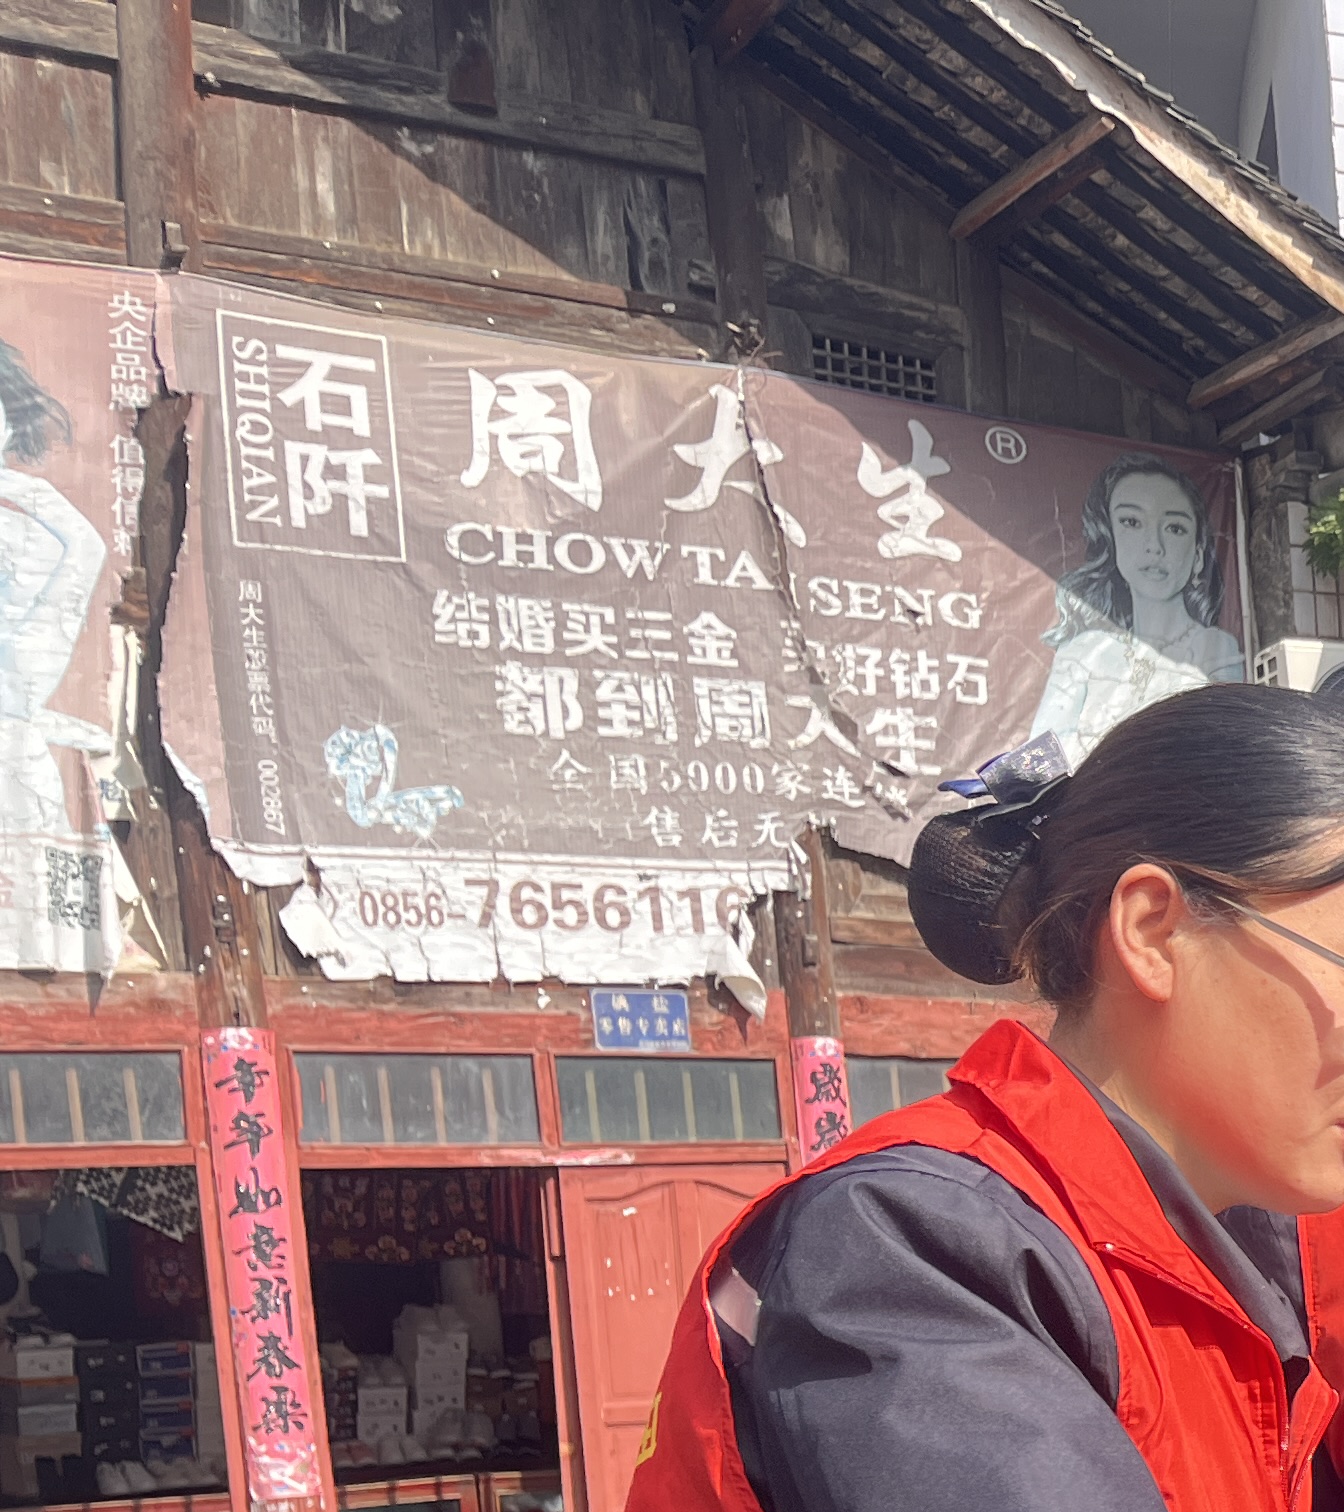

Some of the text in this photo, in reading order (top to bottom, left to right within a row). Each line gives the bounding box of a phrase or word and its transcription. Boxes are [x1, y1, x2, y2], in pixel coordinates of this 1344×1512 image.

[232, 335, 283, 528] SHIQIAN
[275, 343, 390, 538] 石阡
[459, 367, 963, 563] 周大生
[432, 588, 740, 668] 结婚买三金
[444, 521, 984, 630] CHOW TA SENG
[257, 758, 286, 836] 002867
[643, 806, 838, 850] 售后无
